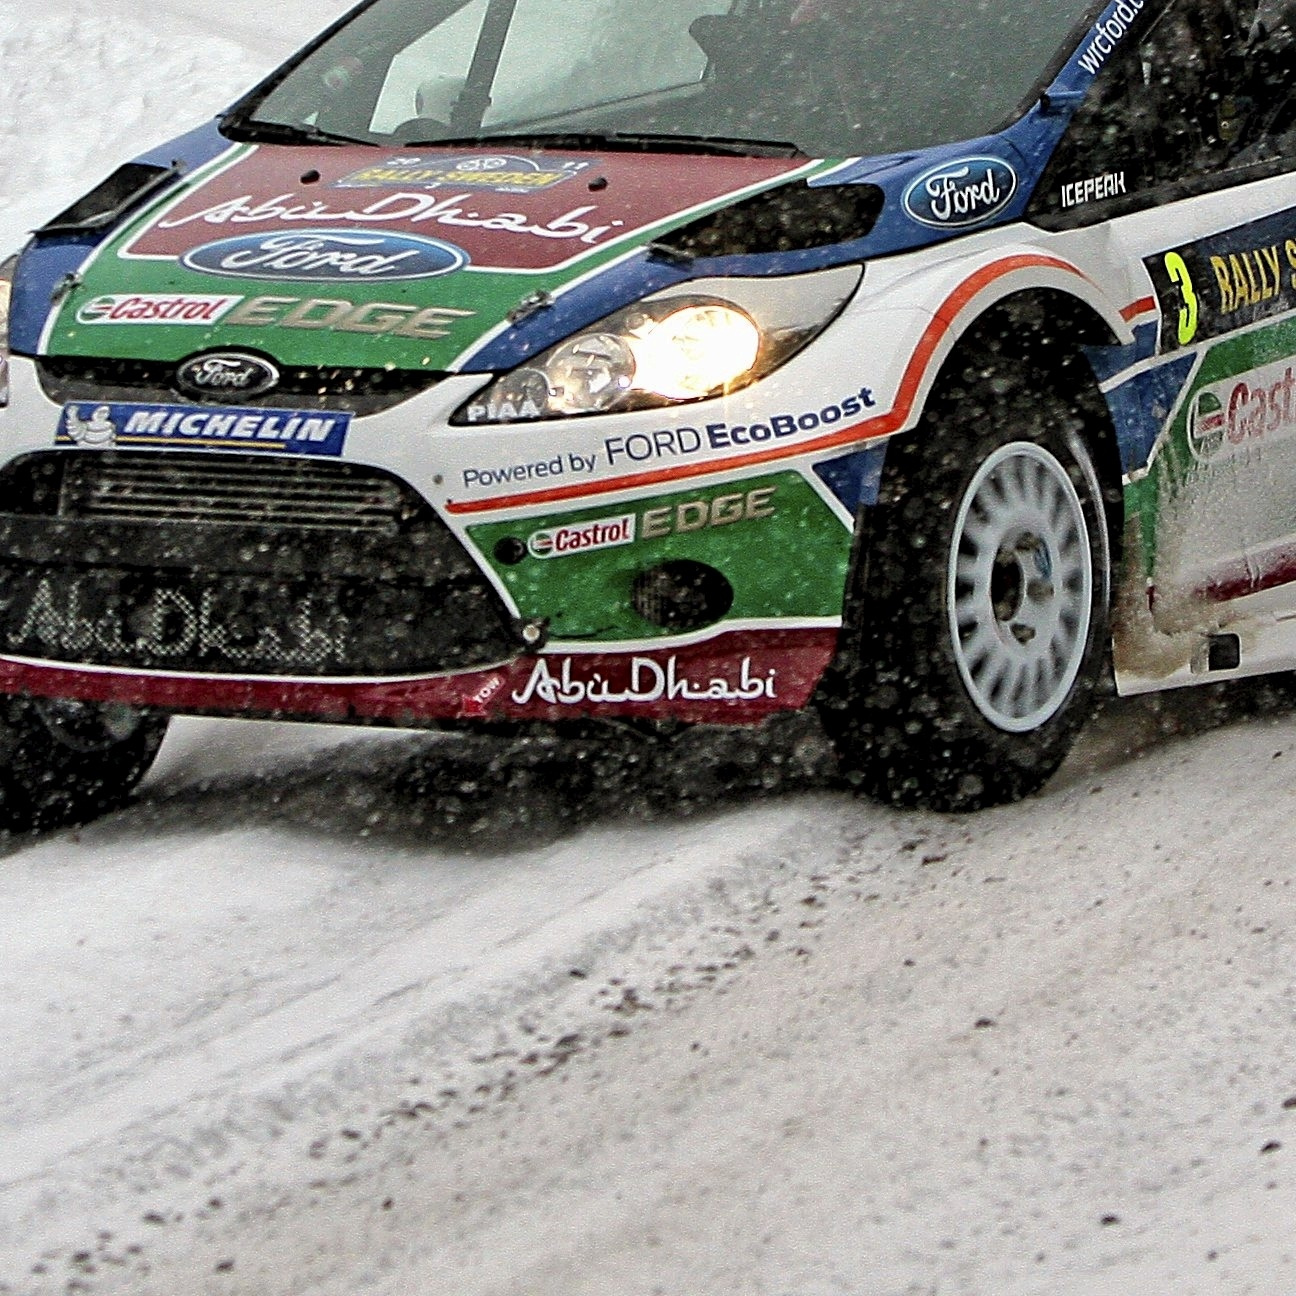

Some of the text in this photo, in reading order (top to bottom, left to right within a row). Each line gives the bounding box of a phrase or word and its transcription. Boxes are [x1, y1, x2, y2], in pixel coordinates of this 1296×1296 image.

[925, 166, 1001, 220] Ford
[1061, 171, 1127, 208] ICEPEAK
[220, 235, 420, 275] Ford
[1165, 252, 1198, 346] 3
[1209, 245, 1281, 315] RALLY
[108, 295, 477, 340] Castrol EDGE
[195, 359, 255, 387] Ford
[121, 410, 338, 445] MICHELIN
[466, 399, 542, 422] PIAA
[463, 386, 877, 489] Powered by FORD EcoBoost
[555, 485, 778, 553] Castrol EDGE
[472, 677, 501, 704] TOW
